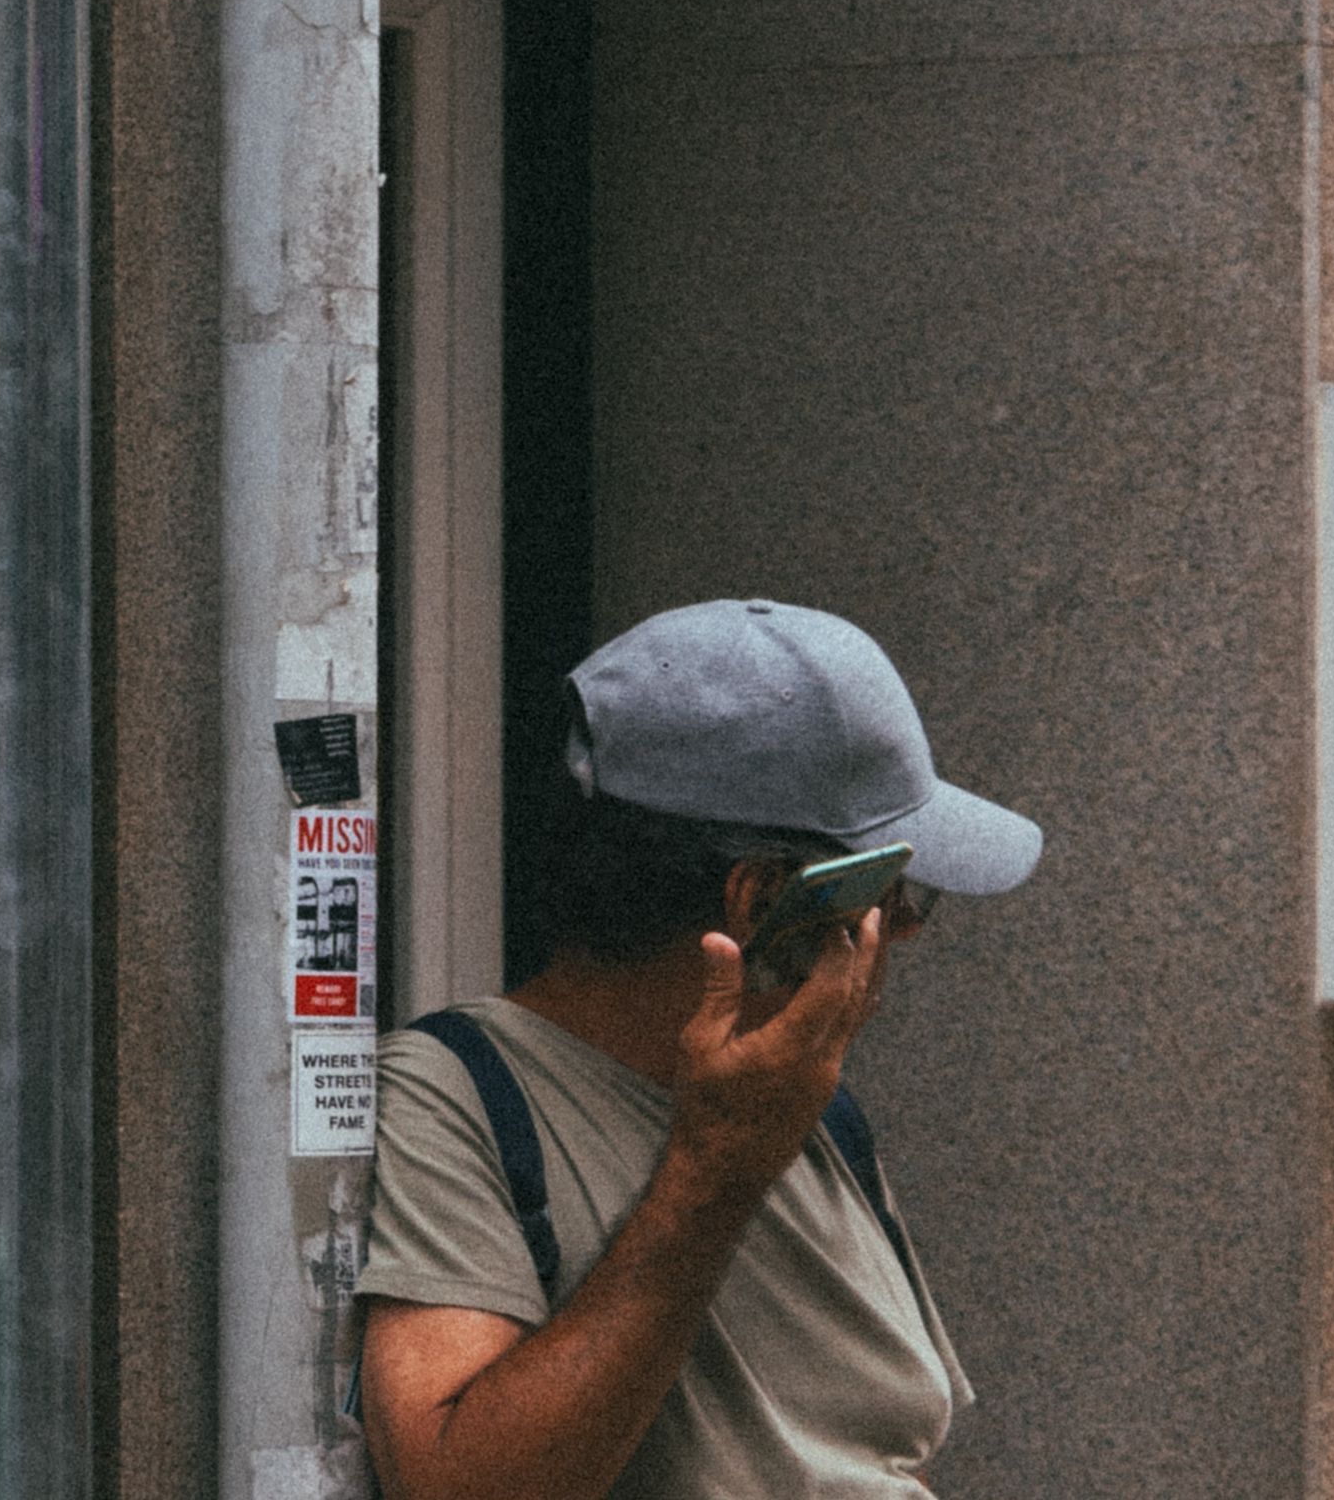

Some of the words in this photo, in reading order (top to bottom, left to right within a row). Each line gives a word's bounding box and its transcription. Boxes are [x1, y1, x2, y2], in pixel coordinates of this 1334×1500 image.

[302, 1053, 358, 1069] WHERE
[314, 1074, 372, 1089] STREETS
[315, 1095, 355, 1109] HAVE
[357, 1095, 372, 1109] NO
[329, 1115, 366, 1130] FAME
